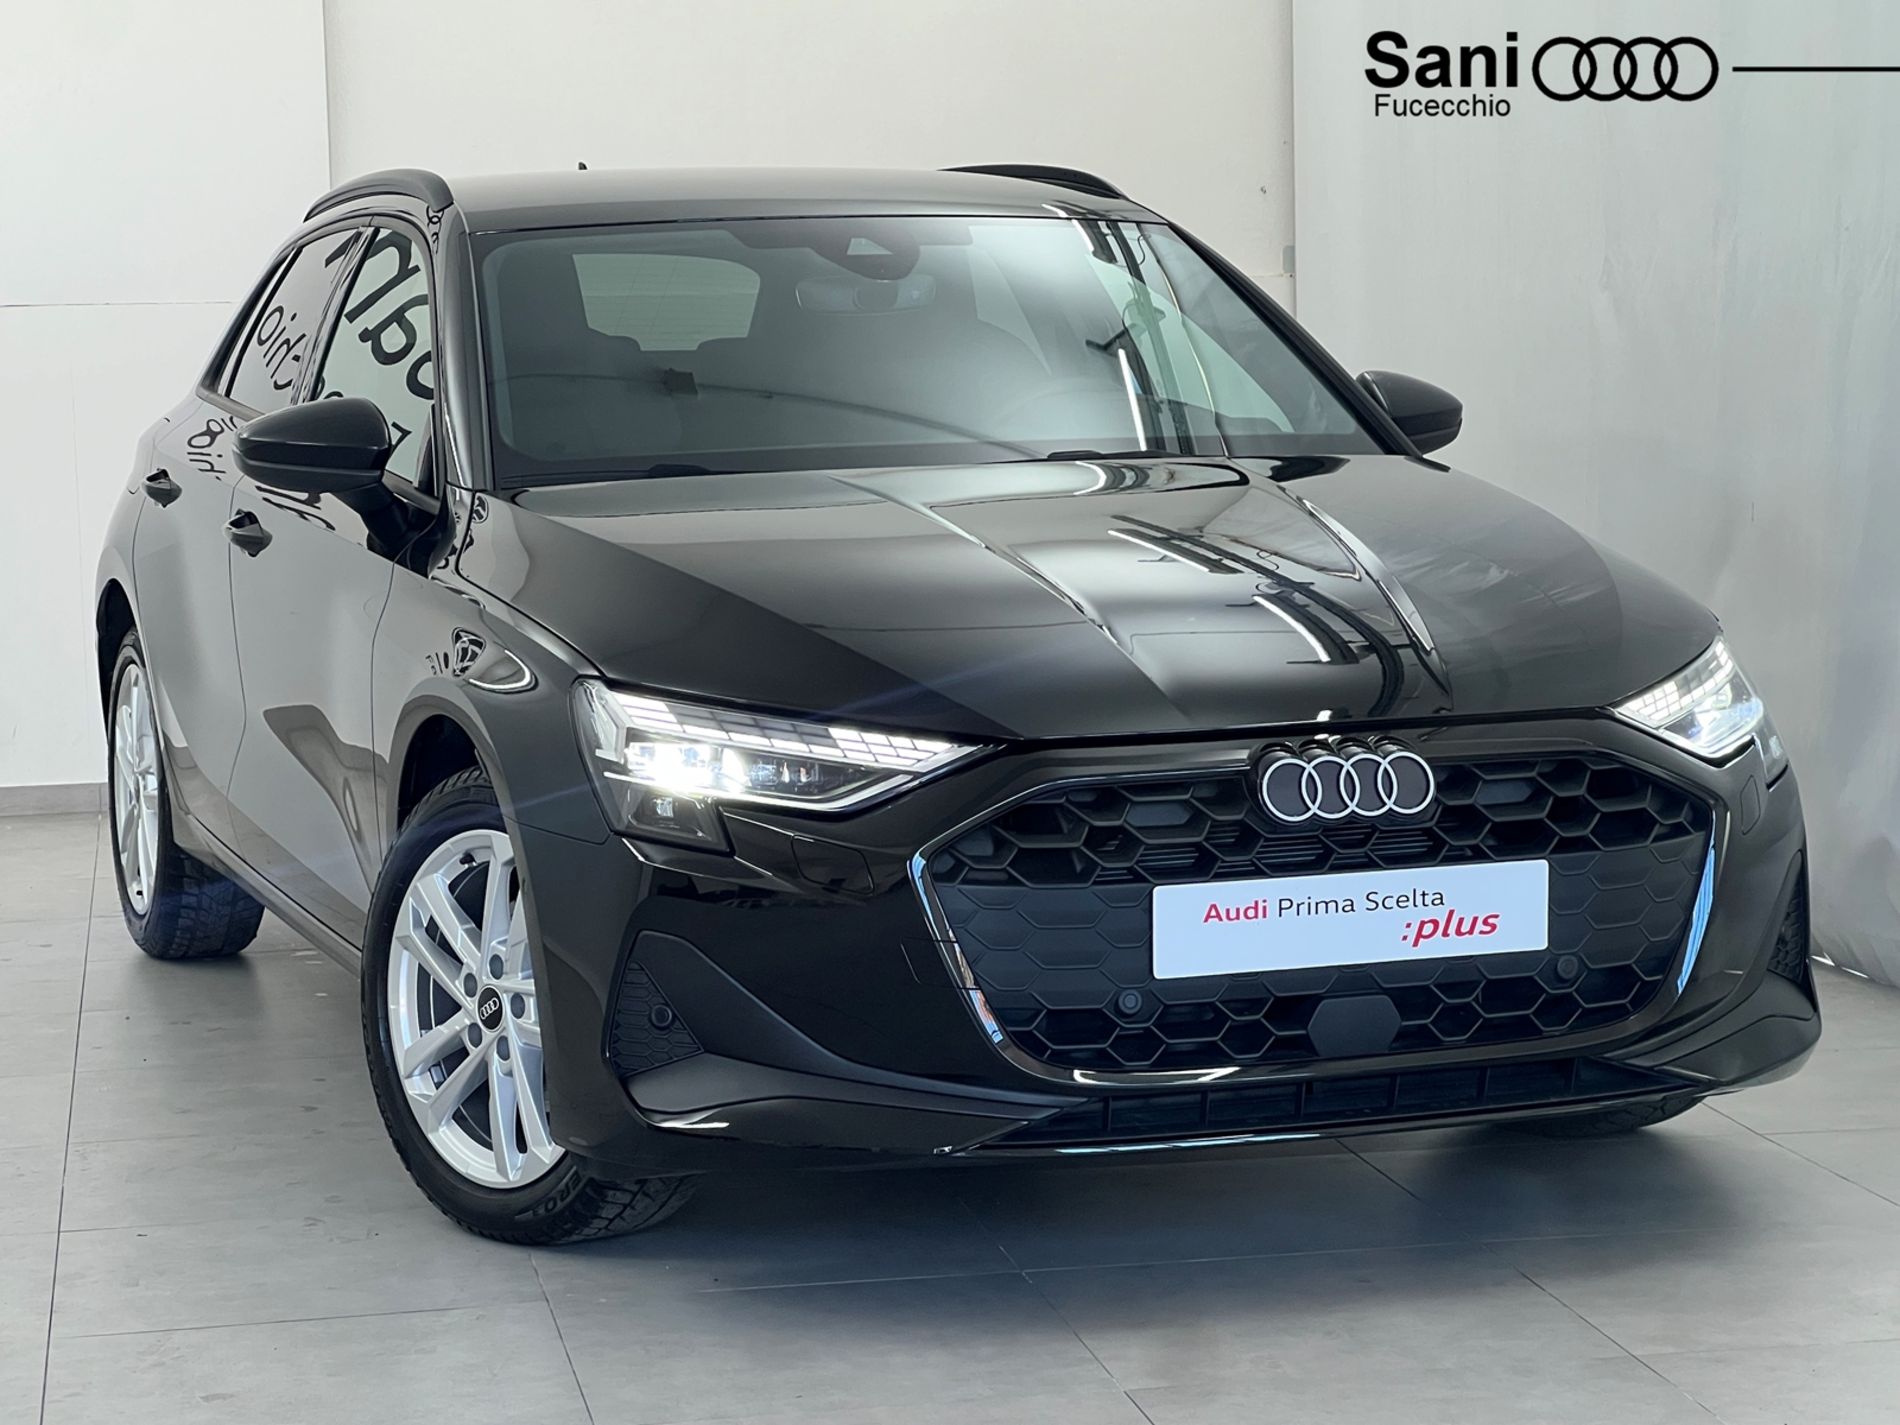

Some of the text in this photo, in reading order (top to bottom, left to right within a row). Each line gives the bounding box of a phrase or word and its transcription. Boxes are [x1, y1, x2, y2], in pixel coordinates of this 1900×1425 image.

[1203, 888, 1445, 923] Audi Prima Scelta
[1401, 909, 1500, 947] :plus
